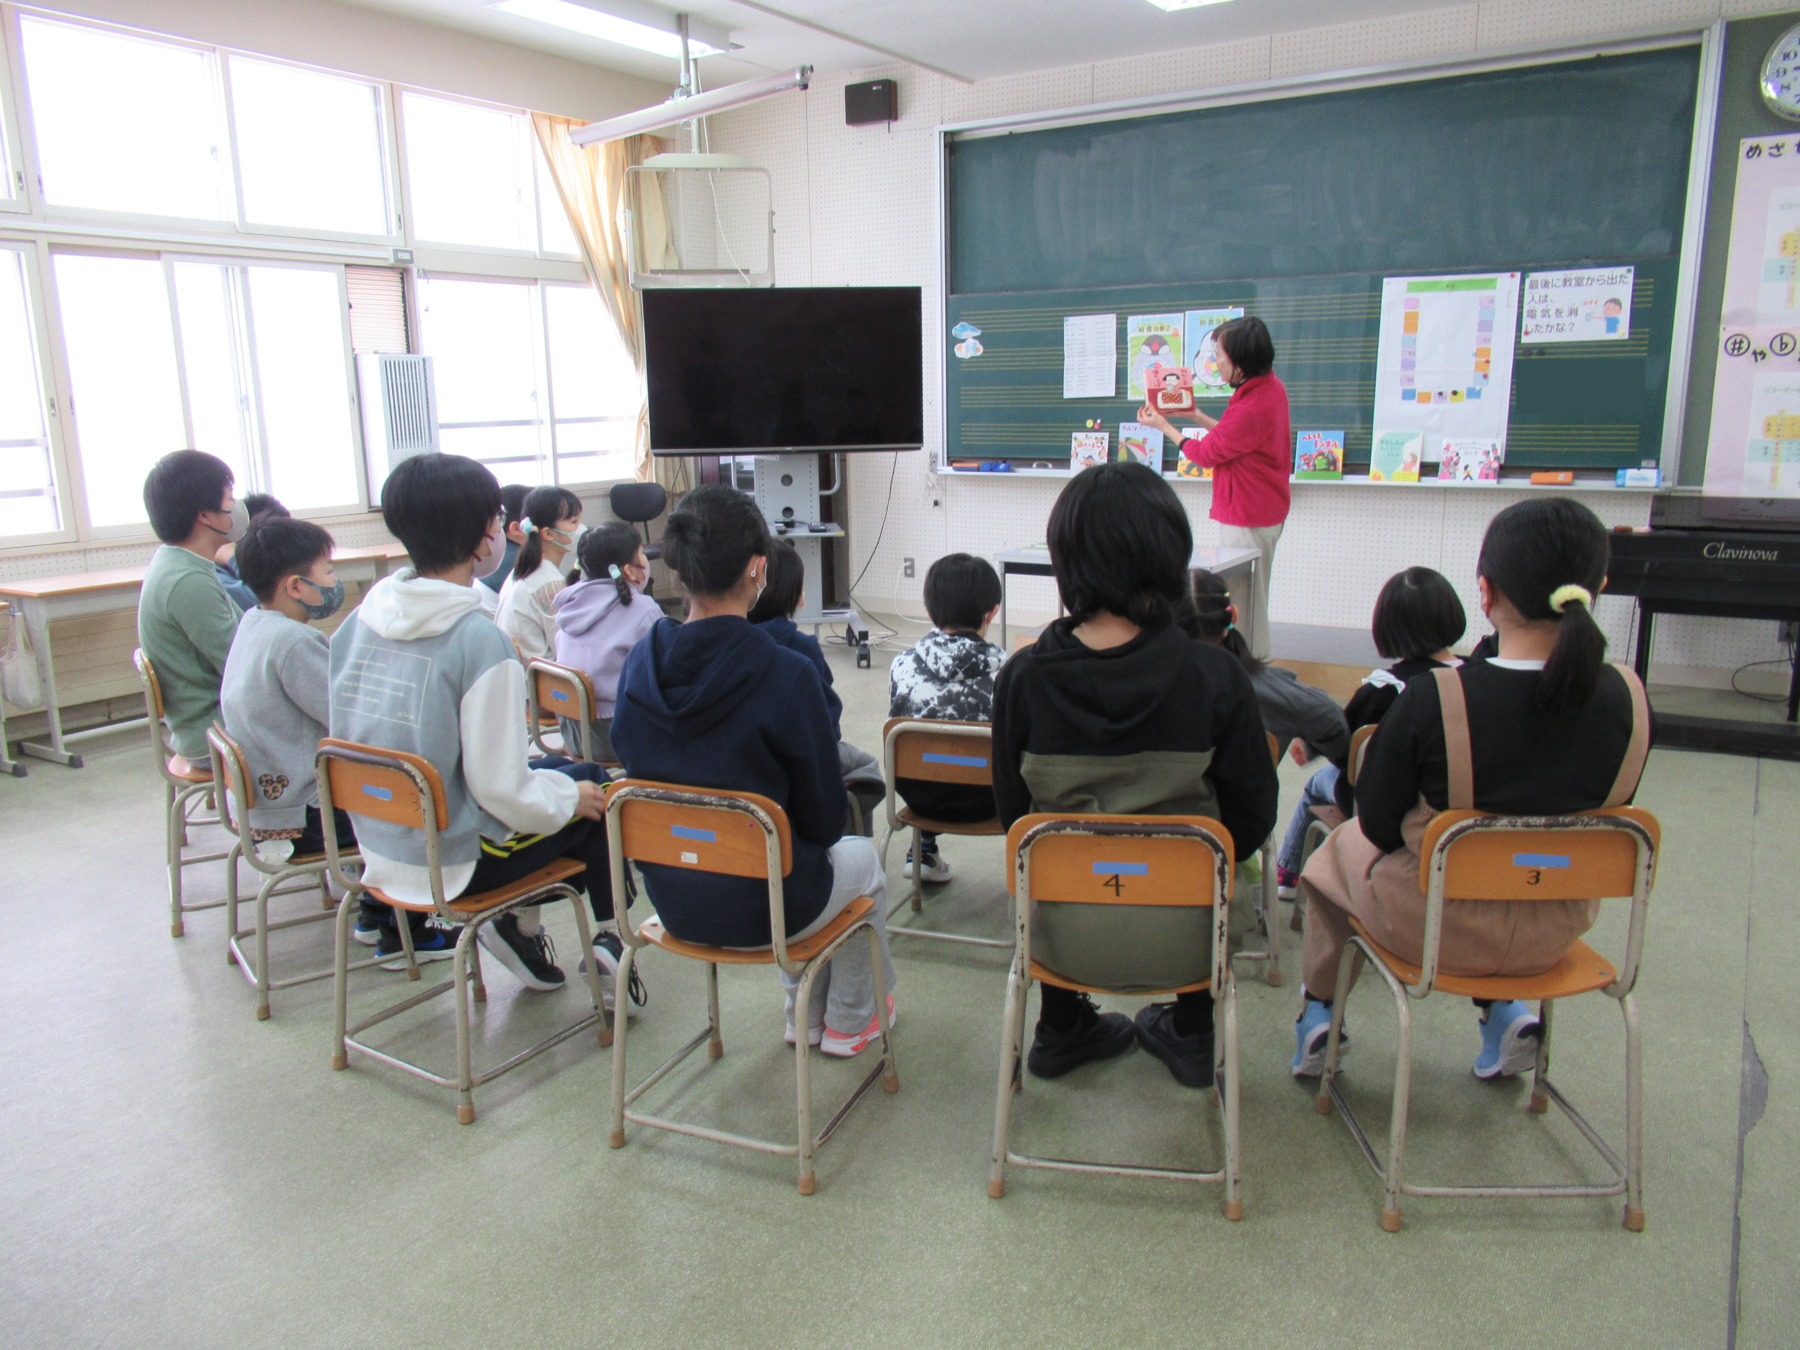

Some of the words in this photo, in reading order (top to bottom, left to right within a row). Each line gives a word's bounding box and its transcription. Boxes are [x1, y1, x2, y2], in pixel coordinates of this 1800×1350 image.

[1782, 50, 1798, 61] 10
[1528, 273, 1629, 290] 最後に教室から出た
[1527, 293, 1553, 305] 人は、
[1526, 306, 1579, 319] 電気を消
[1525, 322, 1575, 334] したかな？
[1314, 440, 1339, 449] トンネル
[1703, 541, 1778, 561] Clavinova
[1526, 869, 1542, 886] 3
[1102, 873, 1126, 897] 4
